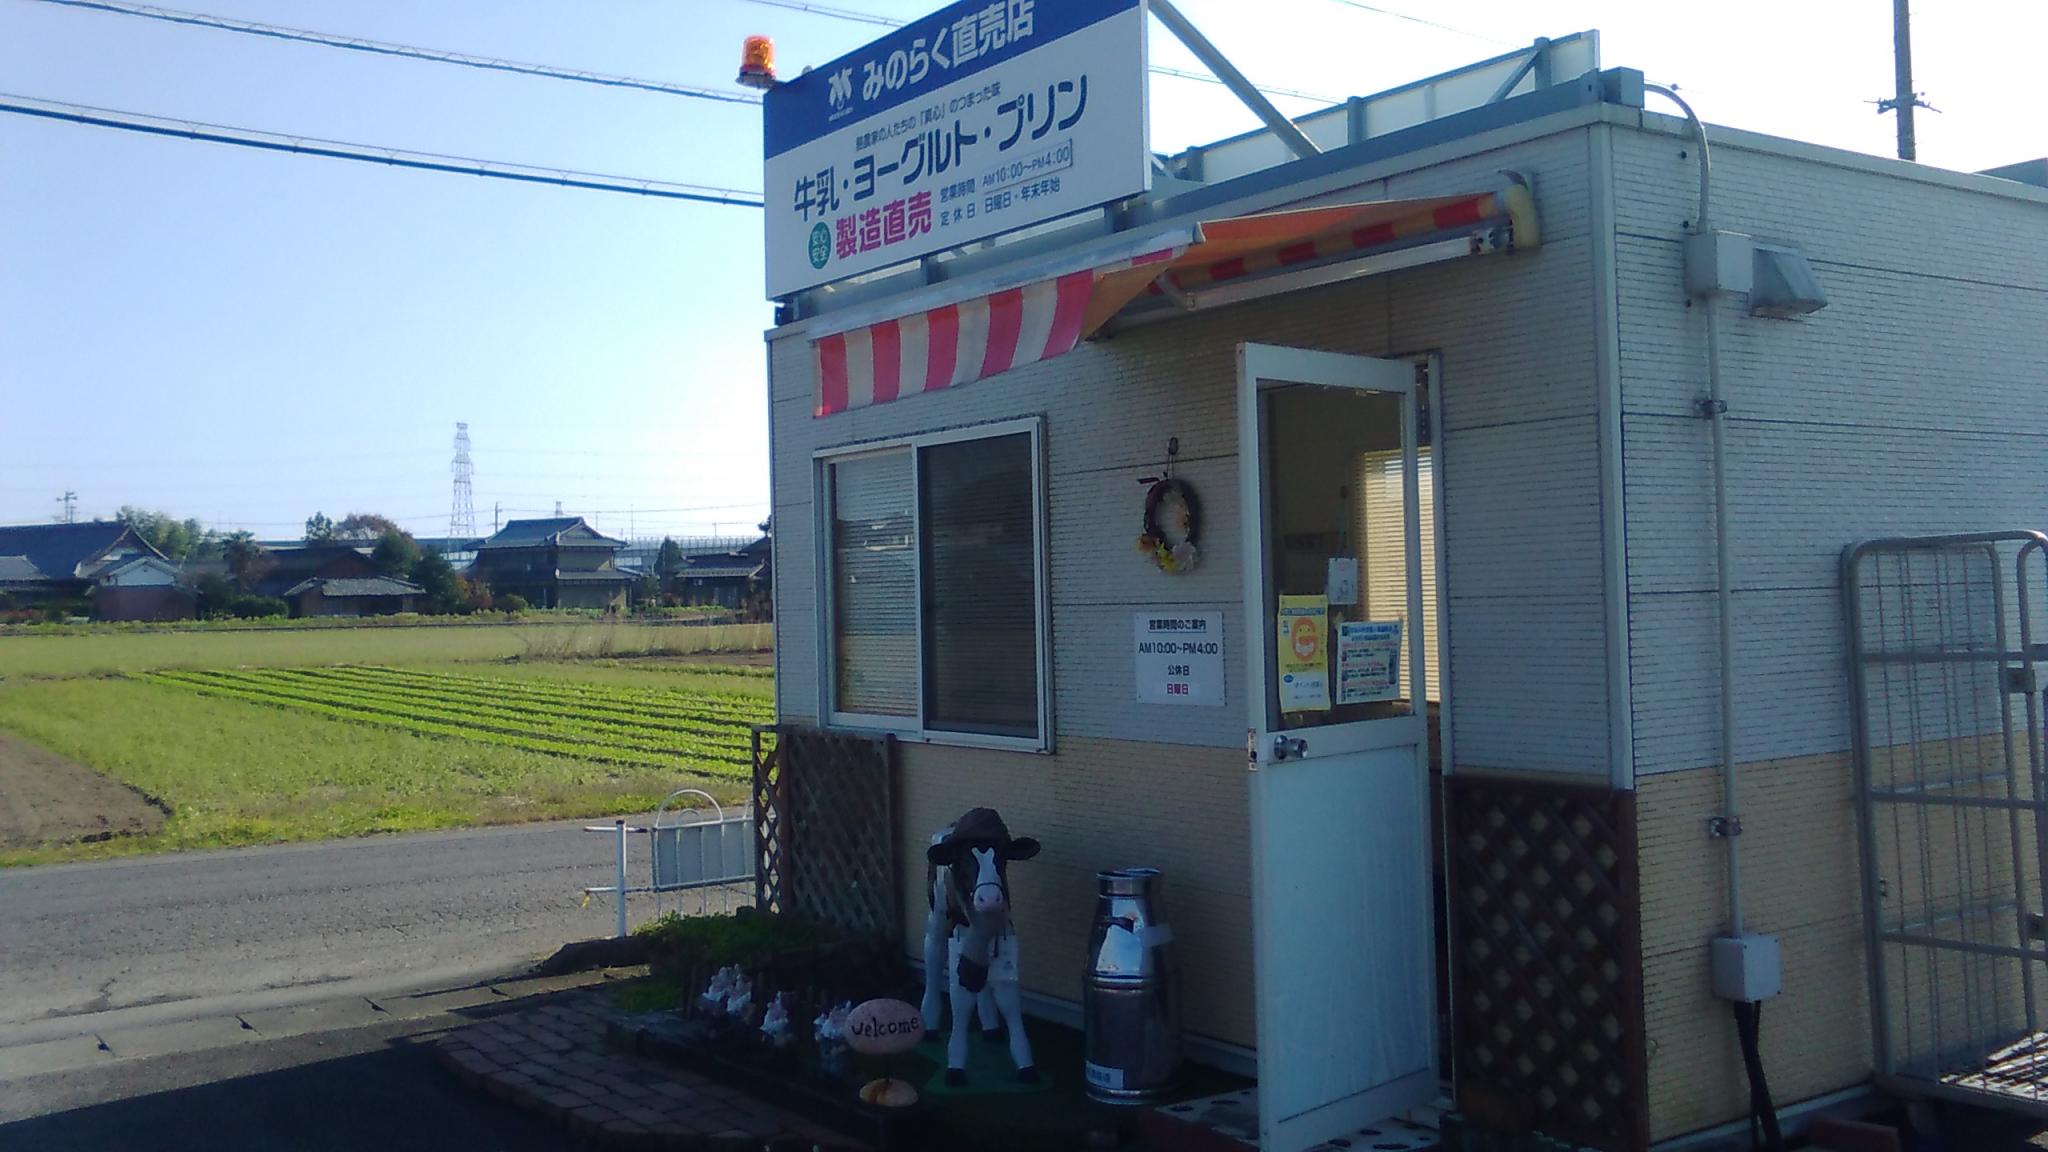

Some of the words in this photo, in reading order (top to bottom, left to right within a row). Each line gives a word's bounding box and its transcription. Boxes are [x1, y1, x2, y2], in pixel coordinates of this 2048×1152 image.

[862, 0, 1035, 100] みのらく直売店
[793, 74, 1088, 222] 牛乳・ヨーグルト・プリン
[940, 177, 976, 204] 営業時間
[985, 178, 1060, 214] 日曜日・年末年始
[836, 191, 932, 260] 製造直売
[940, 204, 976, 227] 定休日
[1149, 619, 1206, 630] 営業時間のご案内
[1168, 665, 1190, 676] 公休日
[1167, 684, 1189, 695] 日曜日
